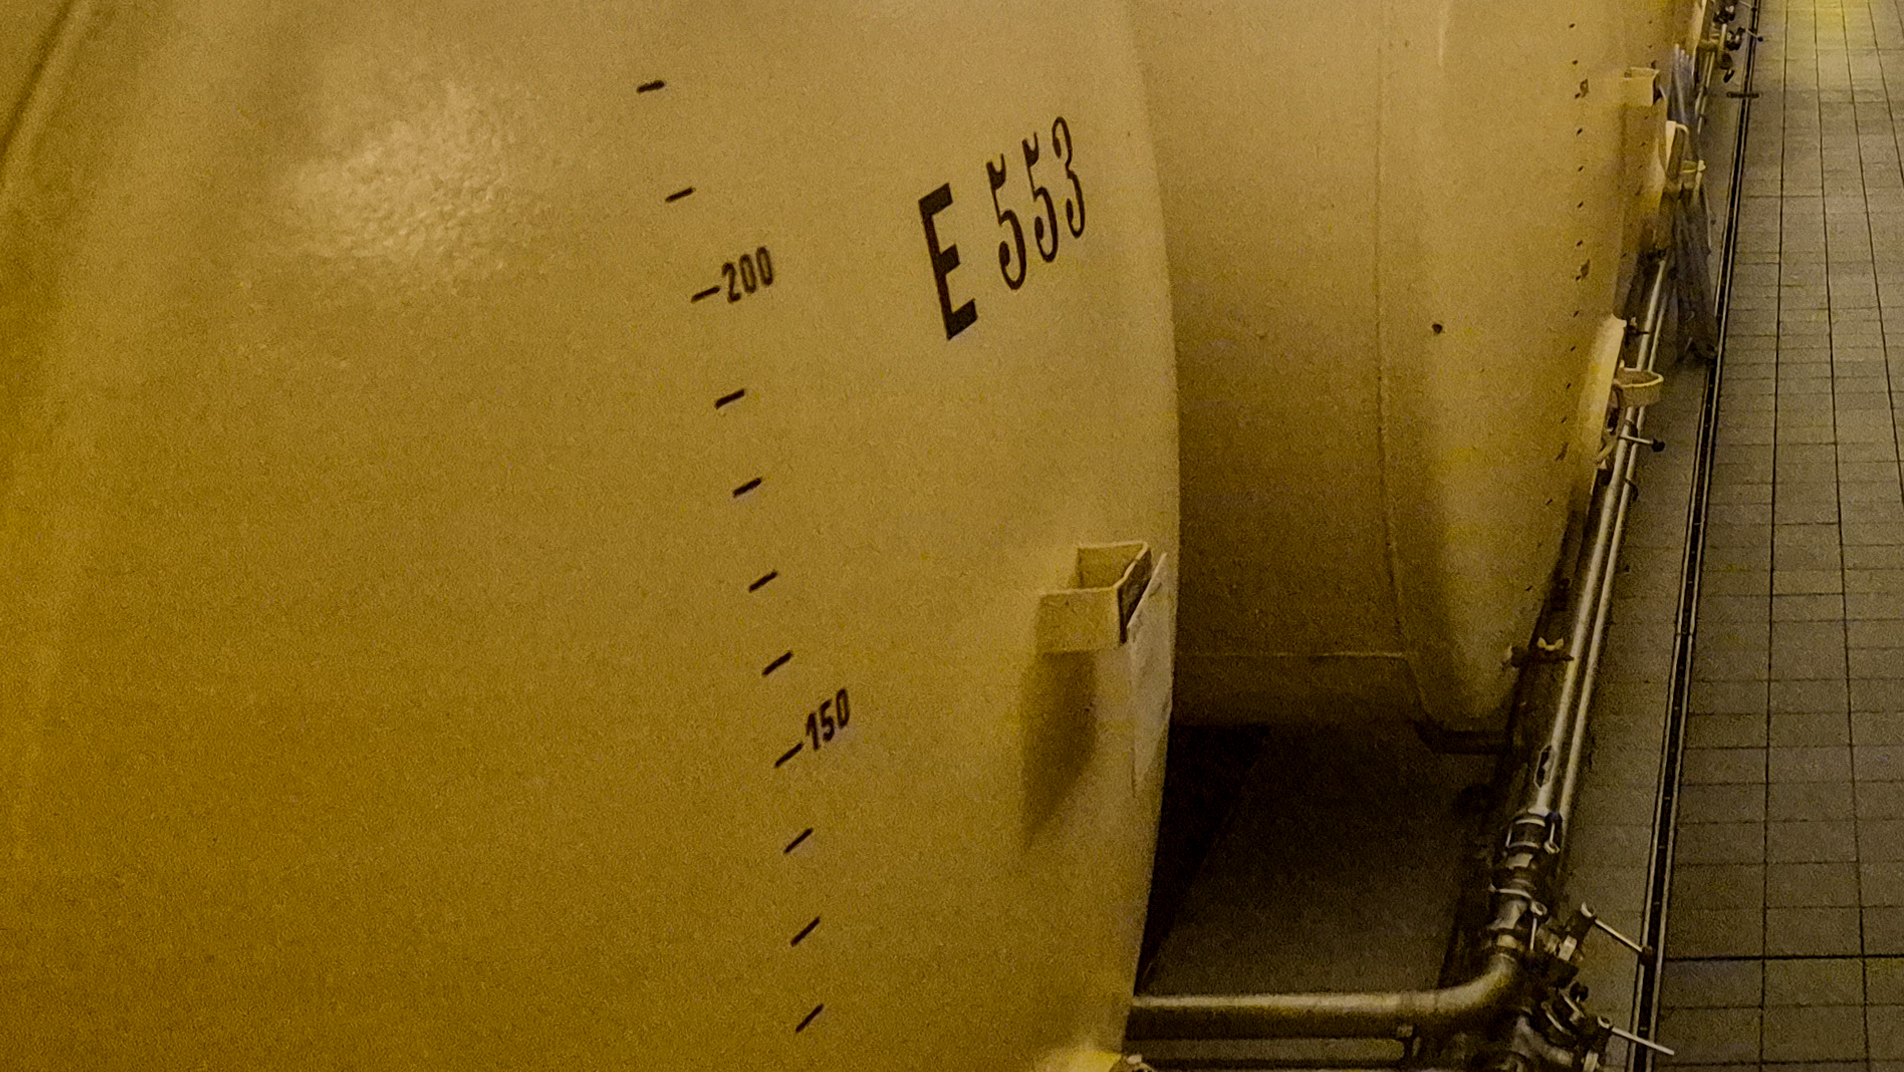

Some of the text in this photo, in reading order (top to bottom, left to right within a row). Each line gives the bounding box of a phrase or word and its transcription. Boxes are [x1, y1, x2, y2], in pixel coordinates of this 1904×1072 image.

[917, 116, 1086, 341] E 553
[721, 246, 774, 304] 200
[805, 688, 851, 752] 150
